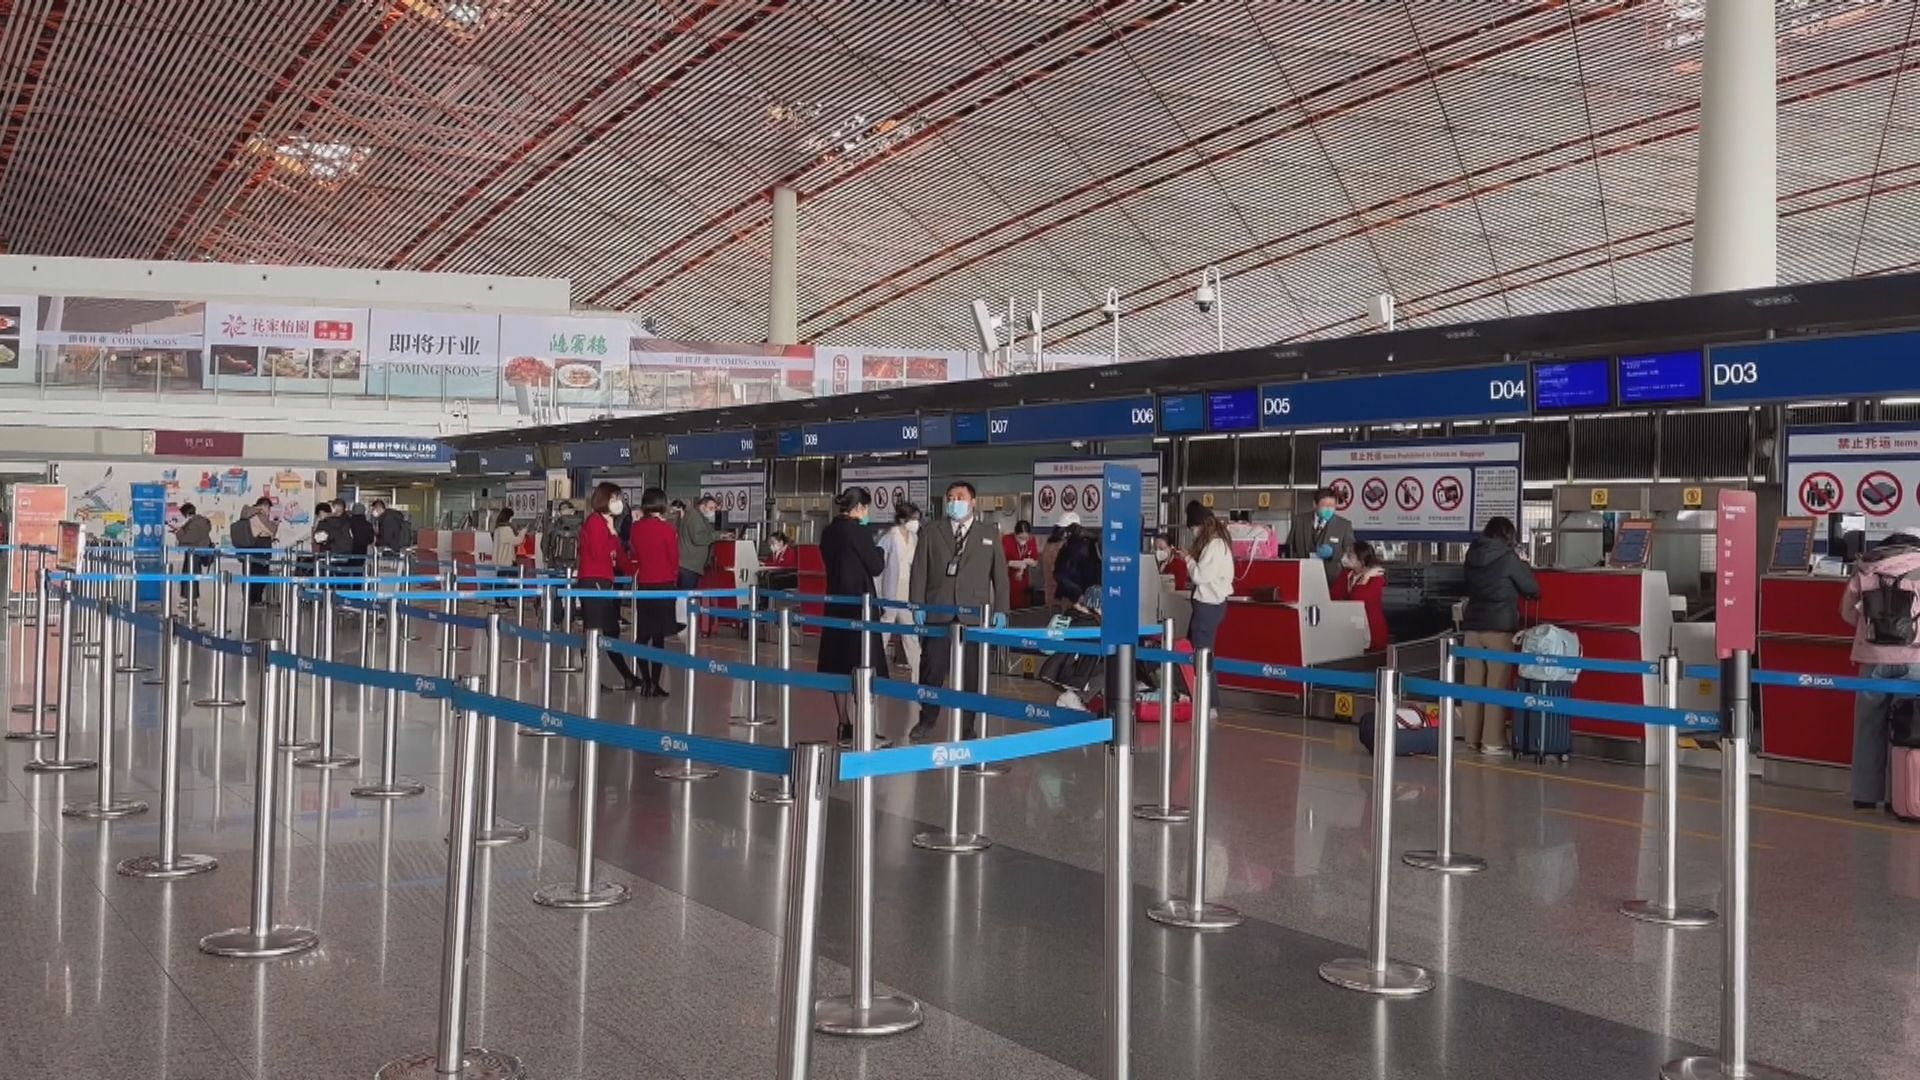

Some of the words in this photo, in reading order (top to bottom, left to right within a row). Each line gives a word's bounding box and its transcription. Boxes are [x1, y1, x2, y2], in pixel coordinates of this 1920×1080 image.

[112, 336, 148, 345] COMING
[389, 333, 480, 355] 即将开业
[715, 357, 750, 366] COMING
[753, 359, 776, 367] SOON
[445, 364, 480, 377] SOON
[1713, 362, 1757, 385] D03
[1490, 380, 1525, 399] D04
[1263, 398, 1290, 415] D05
[1132, 408, 1154, 424] D06
[902, 425, 918, 440] D08
[991, 420, 1008, 433] D07
[741, 439, 753, 451] D10
[805, 434, 818, 445] D09
[1838, 436, 1891, 449] 禁止托运
[1272, 667, 1287, 677] BCIA
[1814, 678, 1834, 686] BCIA
[1537, 700, 1554, 708] BCIA
[1036, 707, 1051, 718] BCIA
[673, 740, 689, 751] BCIA
[948, 747, 971, 762] BCIA
